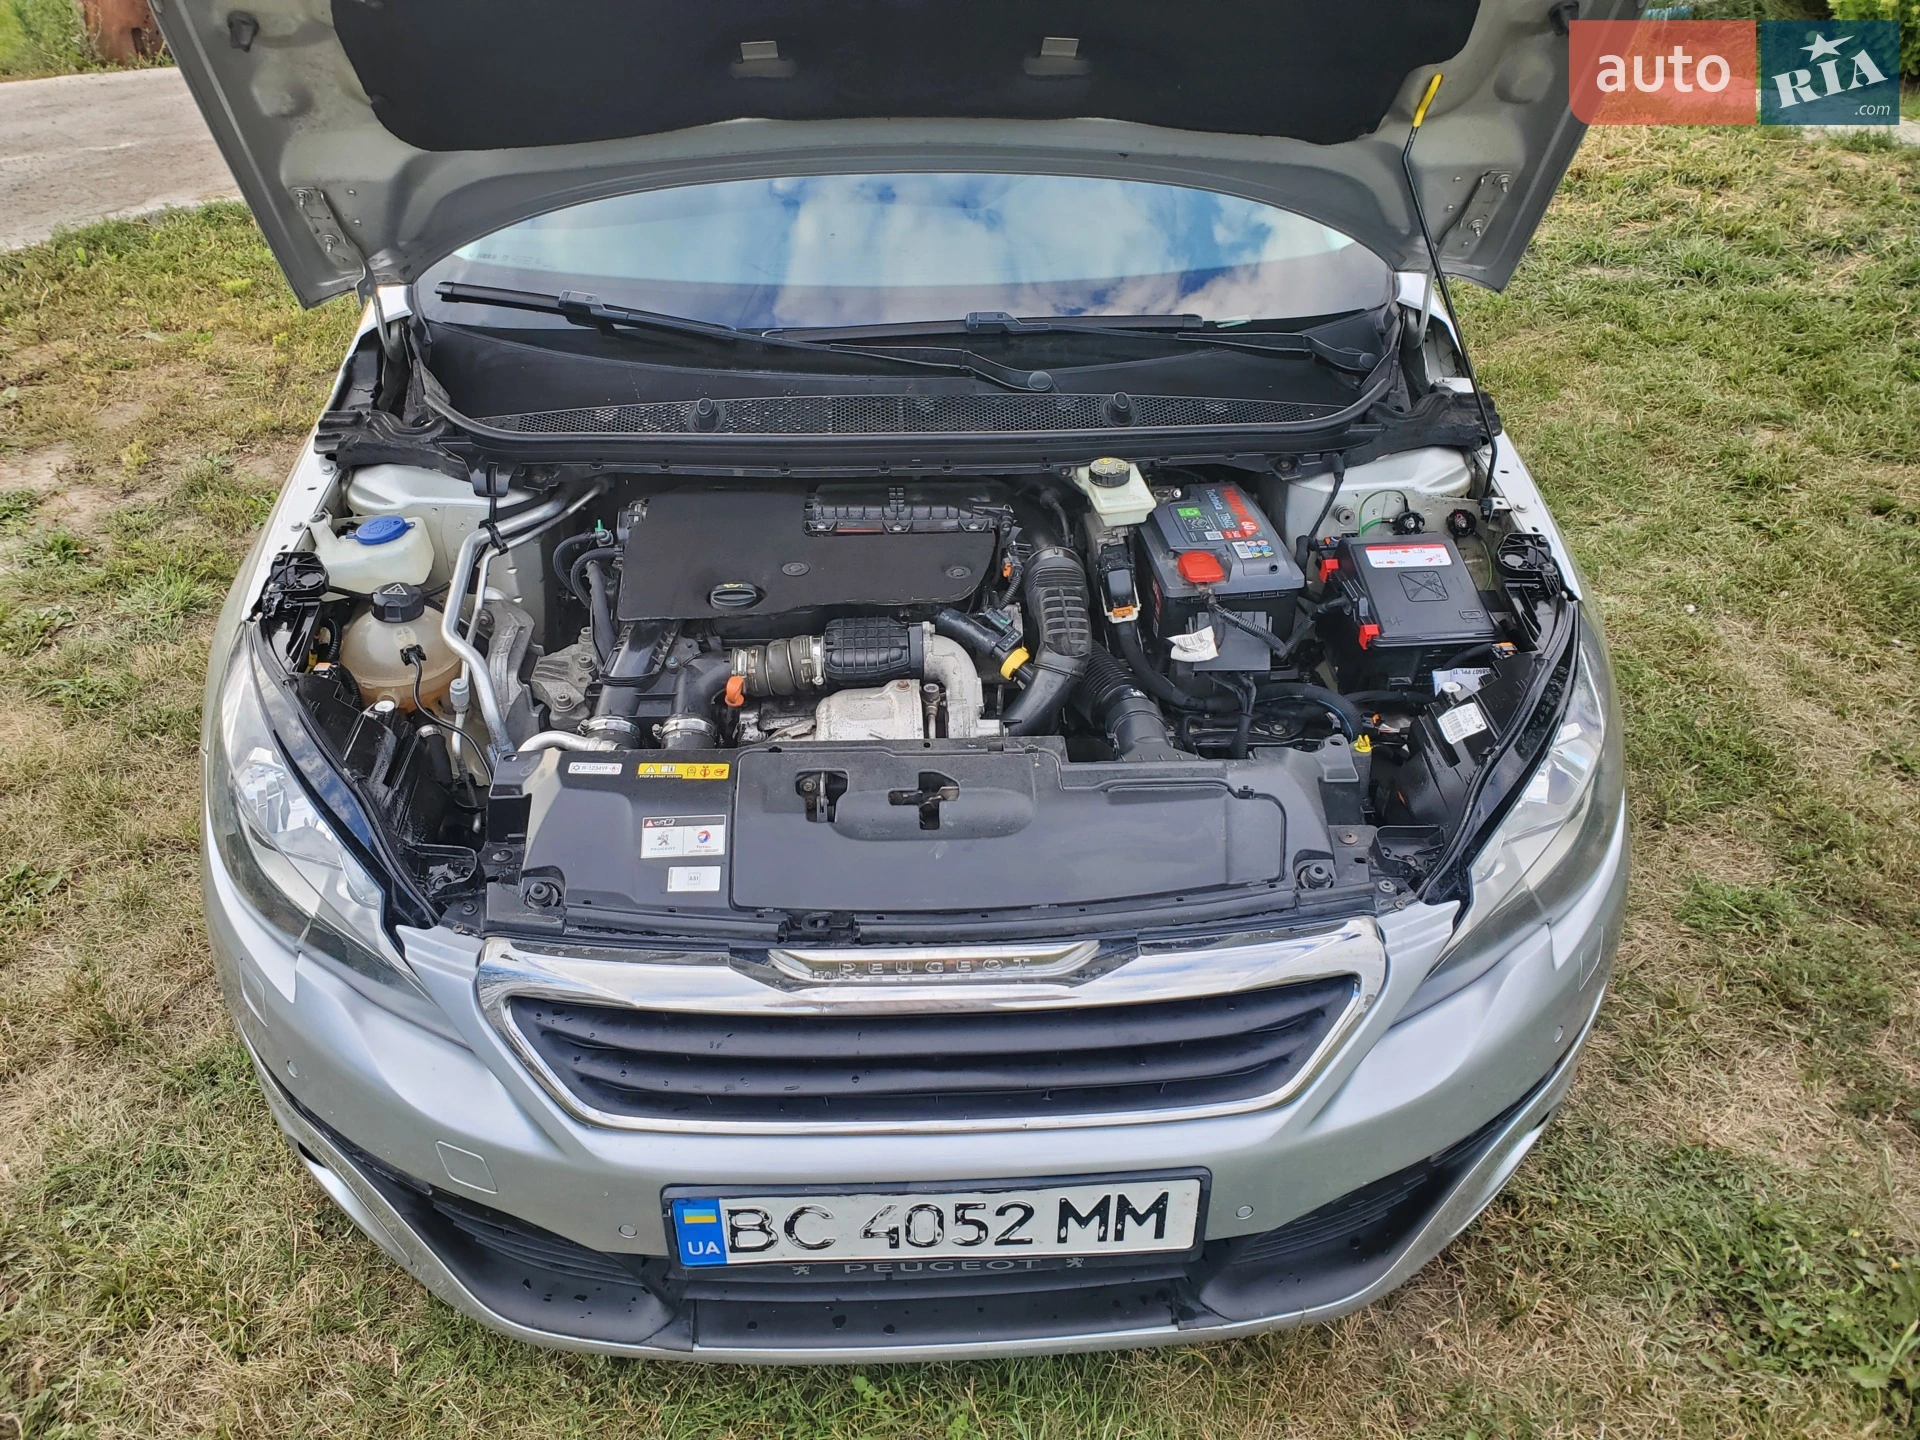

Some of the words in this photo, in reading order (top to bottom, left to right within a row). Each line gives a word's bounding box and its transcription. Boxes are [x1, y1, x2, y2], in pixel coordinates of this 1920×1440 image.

[1205, 489, 1223, 510] Technica
[838, 957, 1031, 974] PEUGEOT
[727, 1203, 836, 1253] BC
[859, 1201, 1035, 1249] 4052
[1057, 1191, 1169, 1244] MM
[688, 1241, 721, 1255] UA
[845, 1259, 1041, 1274] PEUGEOT
